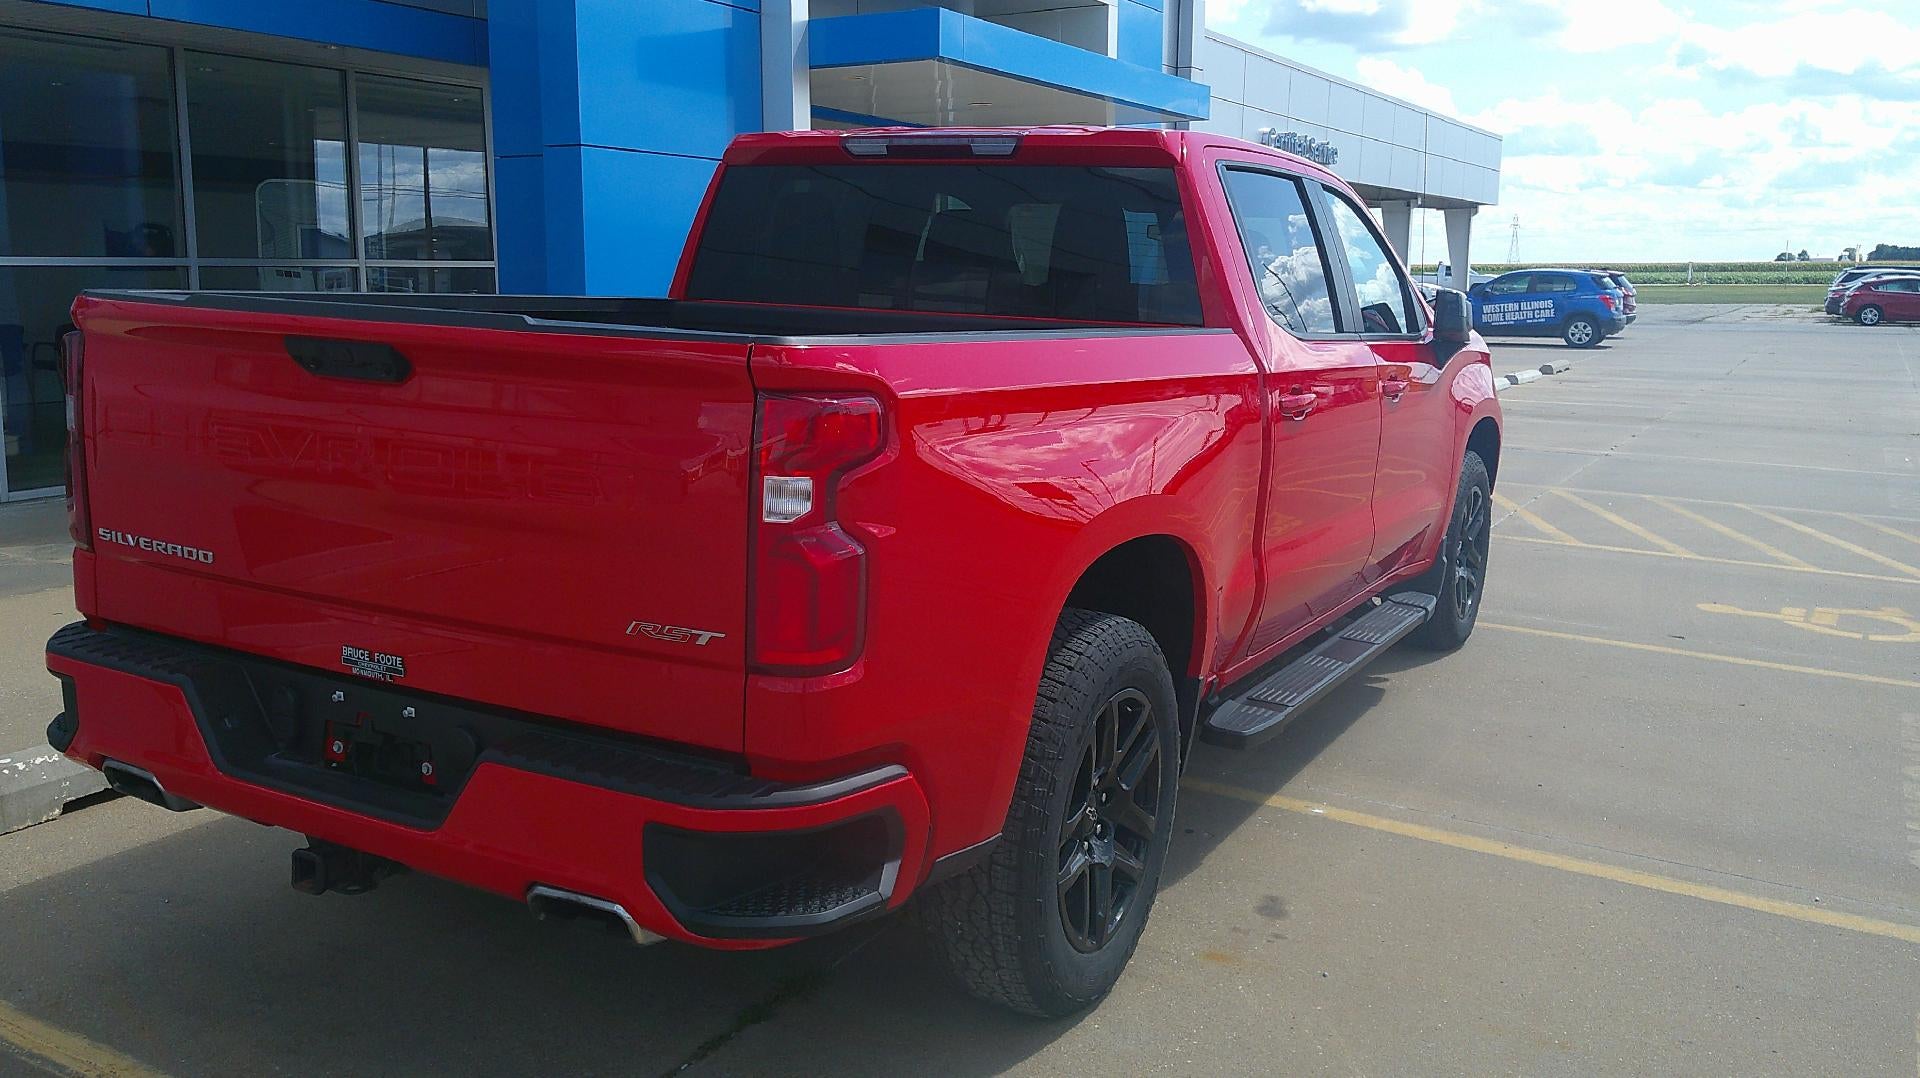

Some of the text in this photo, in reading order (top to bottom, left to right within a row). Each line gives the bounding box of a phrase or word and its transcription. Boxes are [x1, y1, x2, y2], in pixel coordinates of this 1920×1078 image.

[1309, 138, 1339, 164] Service
[1482, 299, 1554, 314] WESTERN ILLINOIS
[1482, 309, 1556, 323] HOME HEALTH CARE
[98, 527, 214, 565] SILVERADO
[626, 621, 725, 645] RST
[342, 646, 403, 667] BRUCE FOOTE
